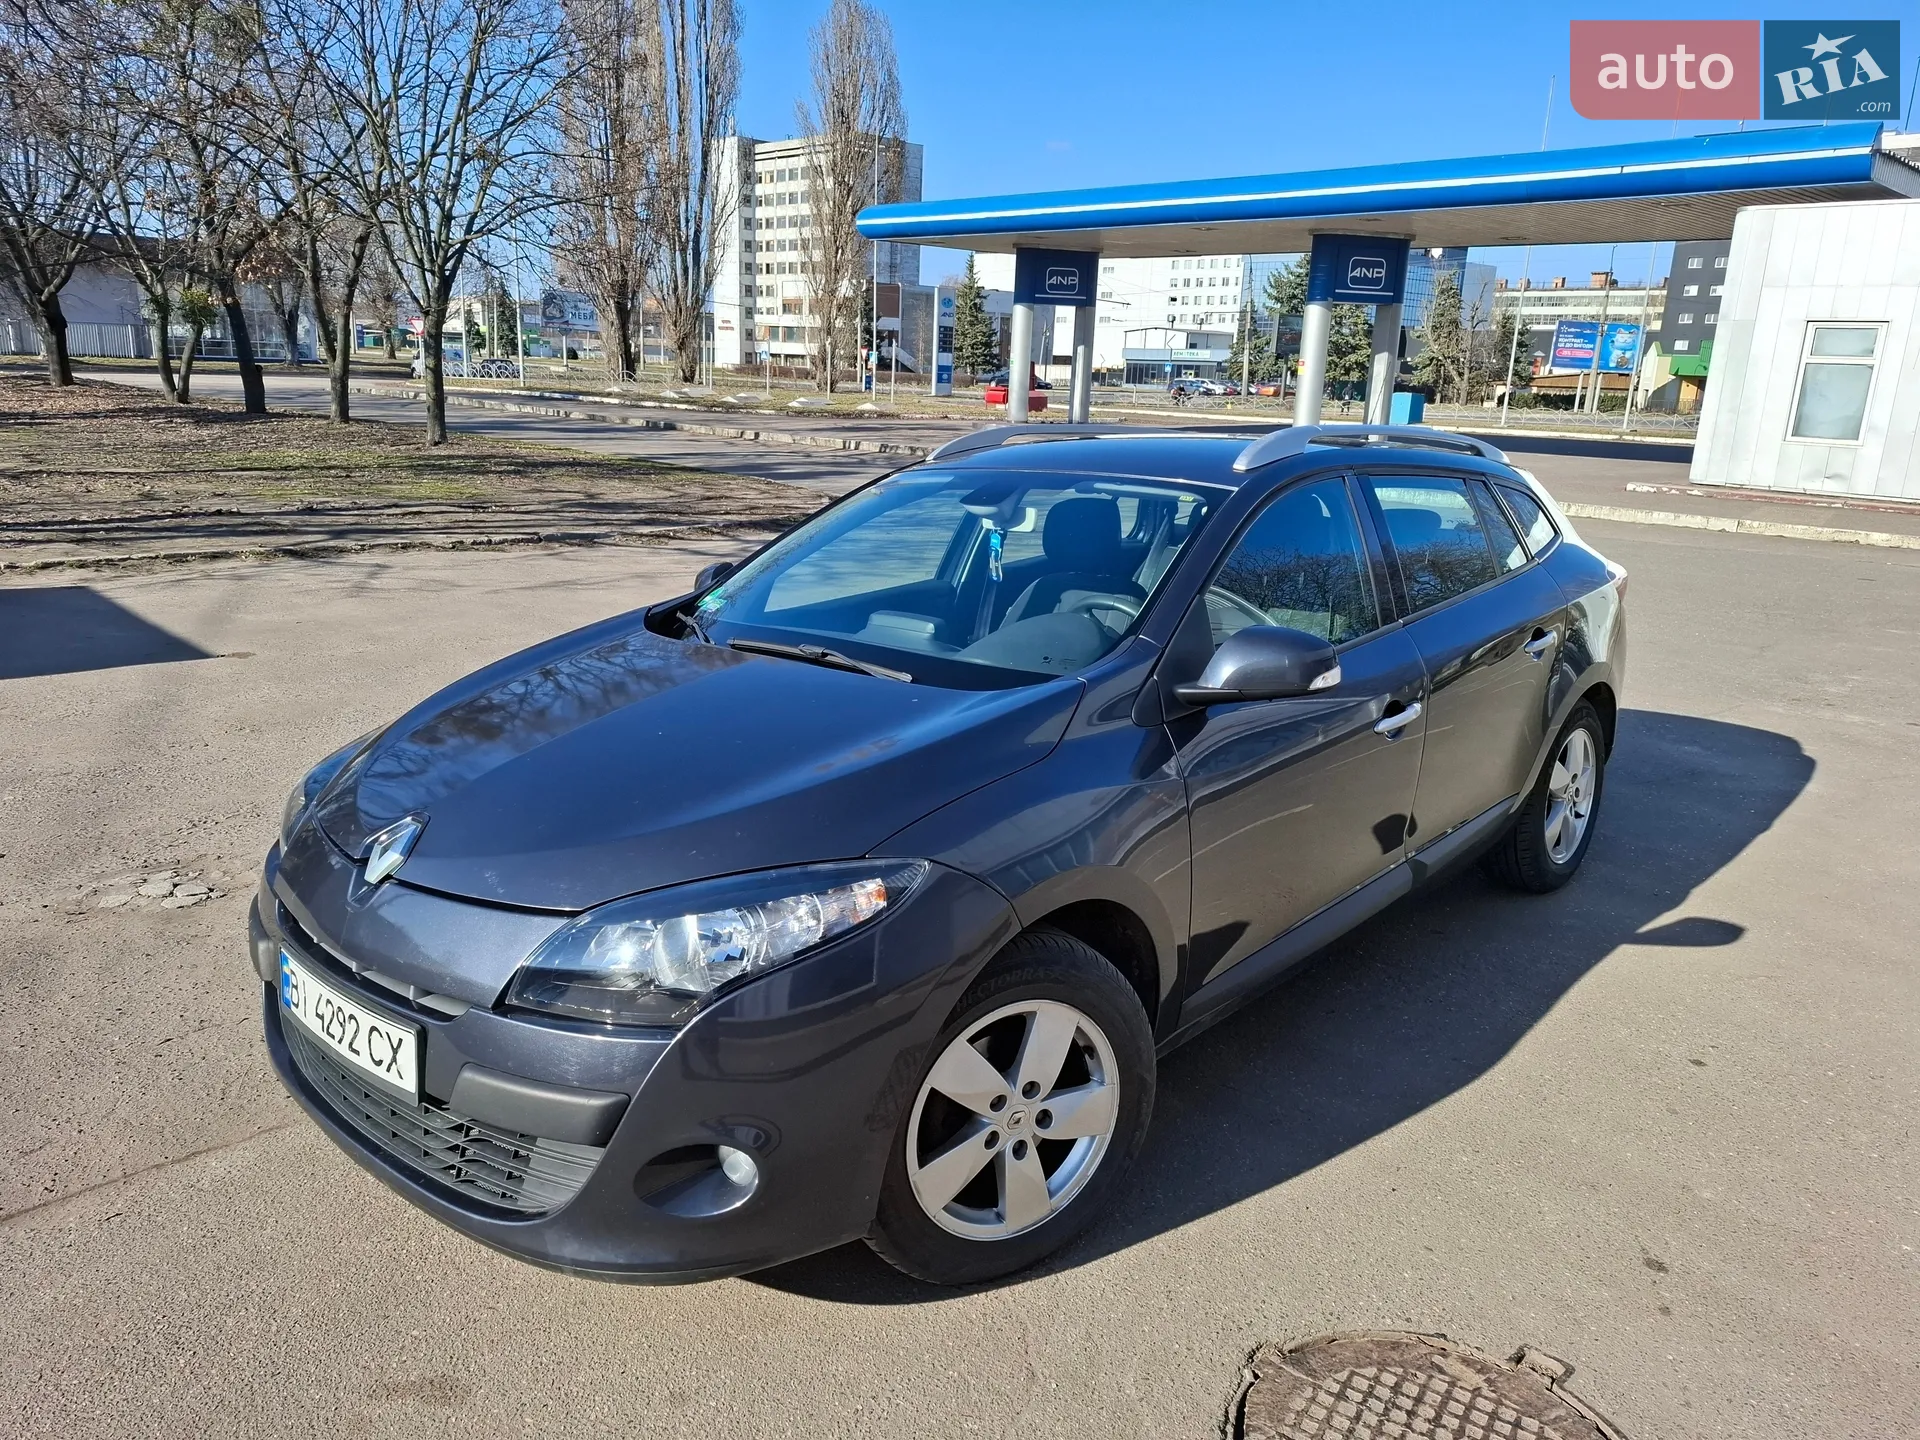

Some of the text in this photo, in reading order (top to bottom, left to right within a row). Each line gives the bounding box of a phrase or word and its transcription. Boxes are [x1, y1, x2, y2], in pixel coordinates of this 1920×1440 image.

[1350, 267, 1384, 278] ANP
[1047, 276, 1078, 285] ANP
[290, 968, 404, 1080] BI 4292 CX
